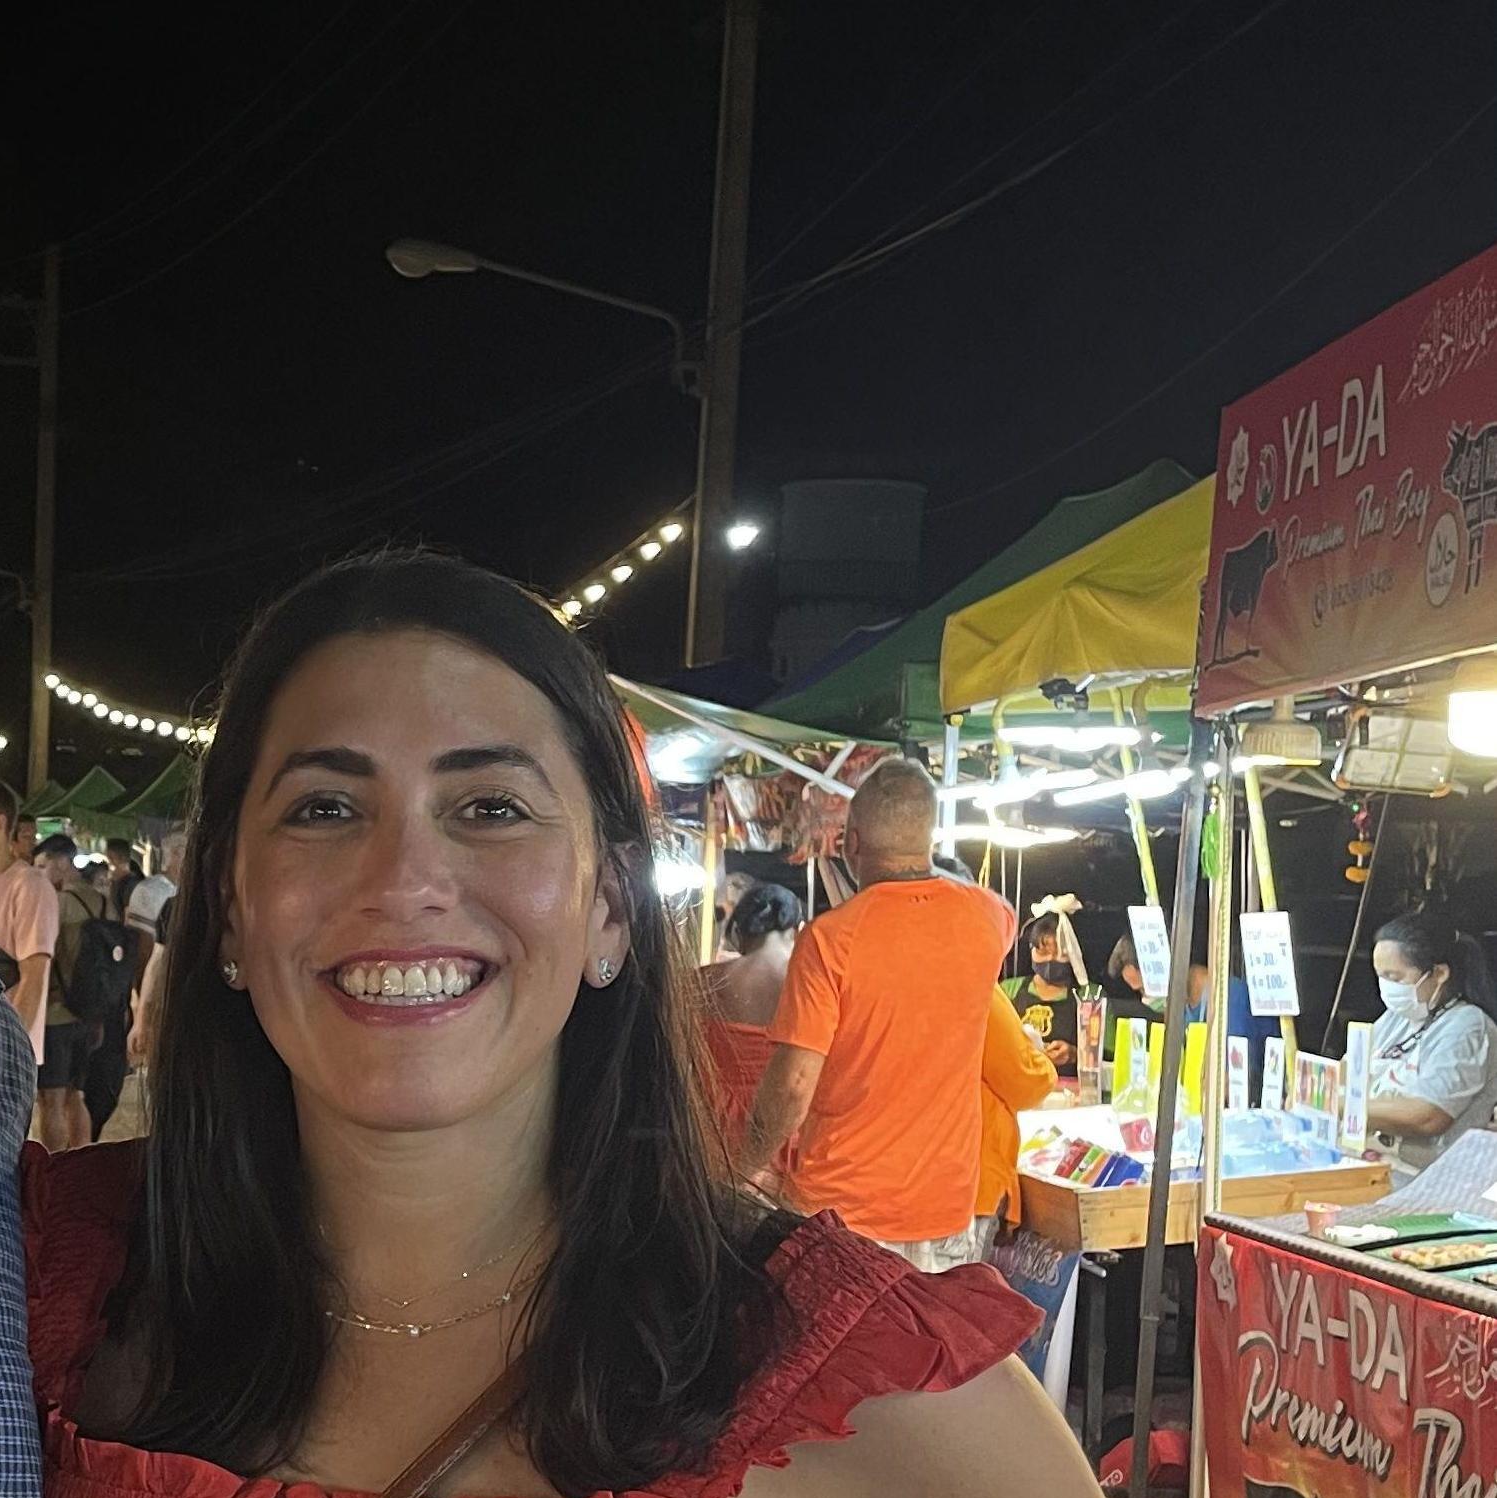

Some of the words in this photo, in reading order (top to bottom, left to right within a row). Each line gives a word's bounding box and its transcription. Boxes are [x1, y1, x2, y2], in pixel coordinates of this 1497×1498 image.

[1282, 365, 1387, 501] YA-DA
[1271, 1262, 1408, 1402] YA-DA
[1237, 1330, 1392, 1478] Premium
